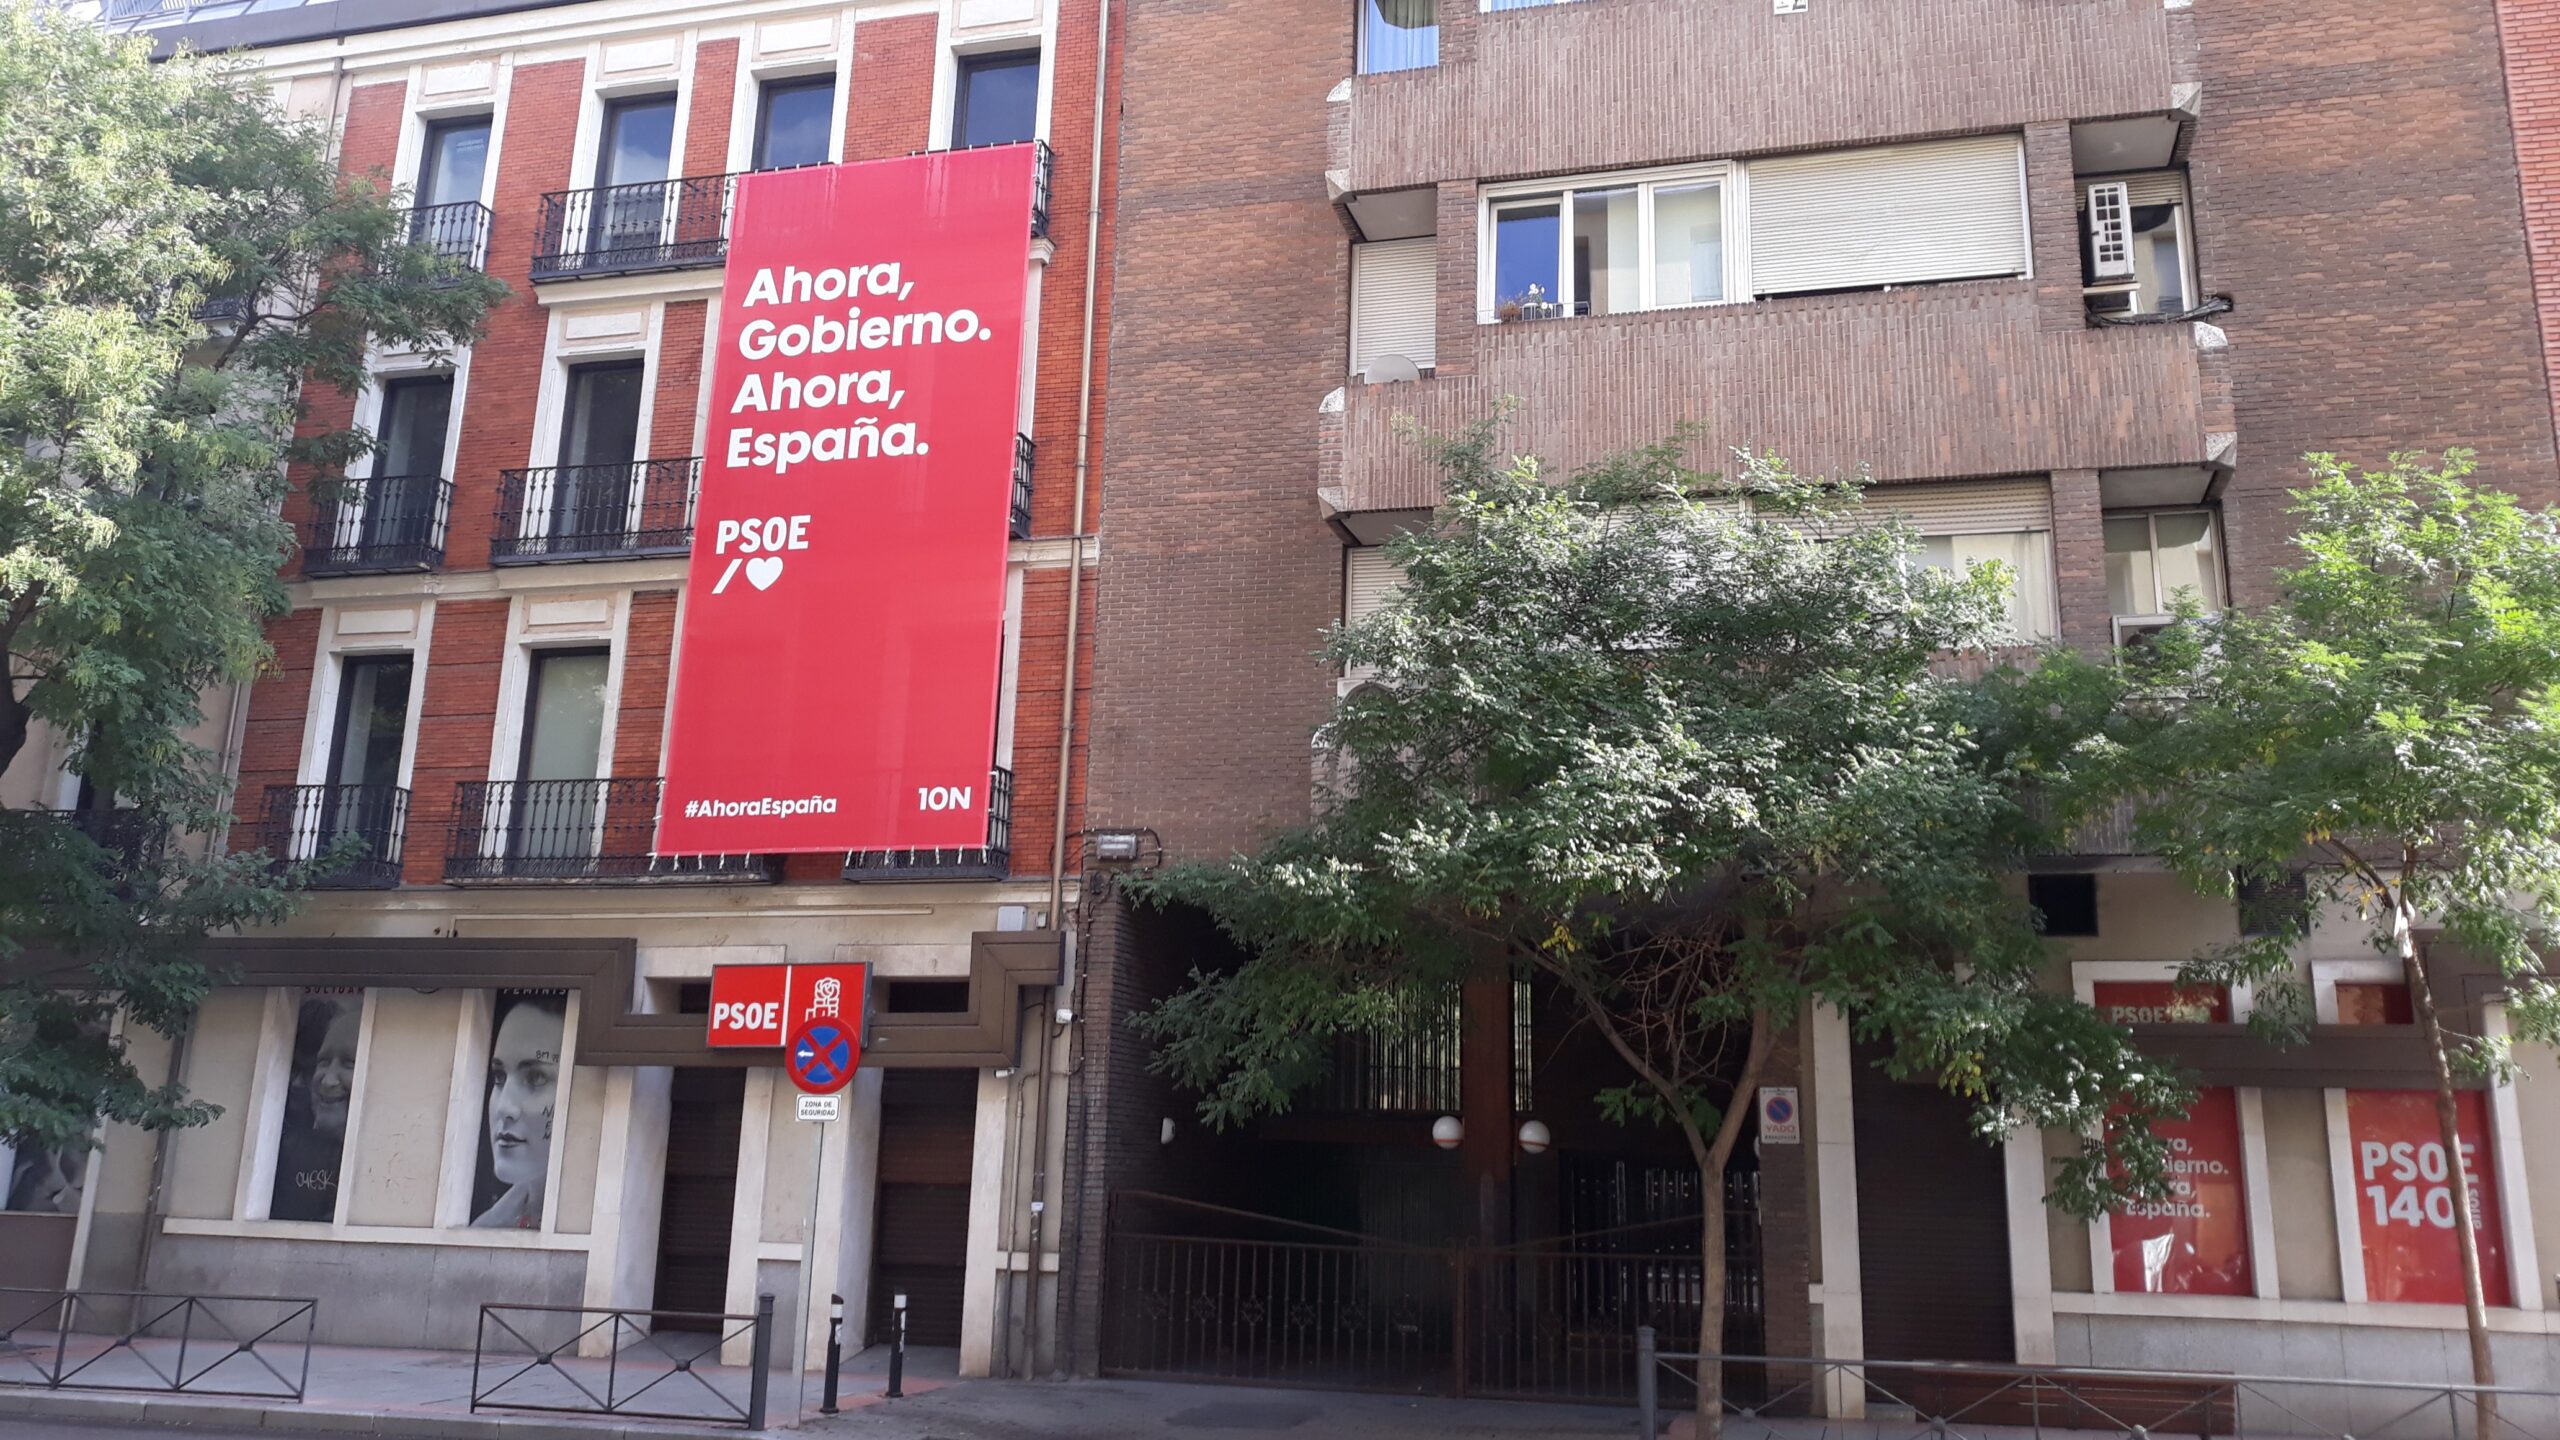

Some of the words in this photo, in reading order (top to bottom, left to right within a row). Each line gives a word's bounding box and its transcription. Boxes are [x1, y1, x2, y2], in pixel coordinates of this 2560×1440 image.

[742, 262, 915, 307] Ahora,
[738, 307, 992, 360] Gobierno.
[730, 369, 906, 414] Ahora,
[726, 417, 929, 474] España.
[715, 514, 811, 554] PSOE
[684, 795, 837, 818] #AhoraEspaña
[918, 786, 971, 810] 10N
[713, 1002, 779, 1030] PSOE
[2112, 1006, 2166, 1024] PSOE
[2365, 1185, 2456, 1229] 140
